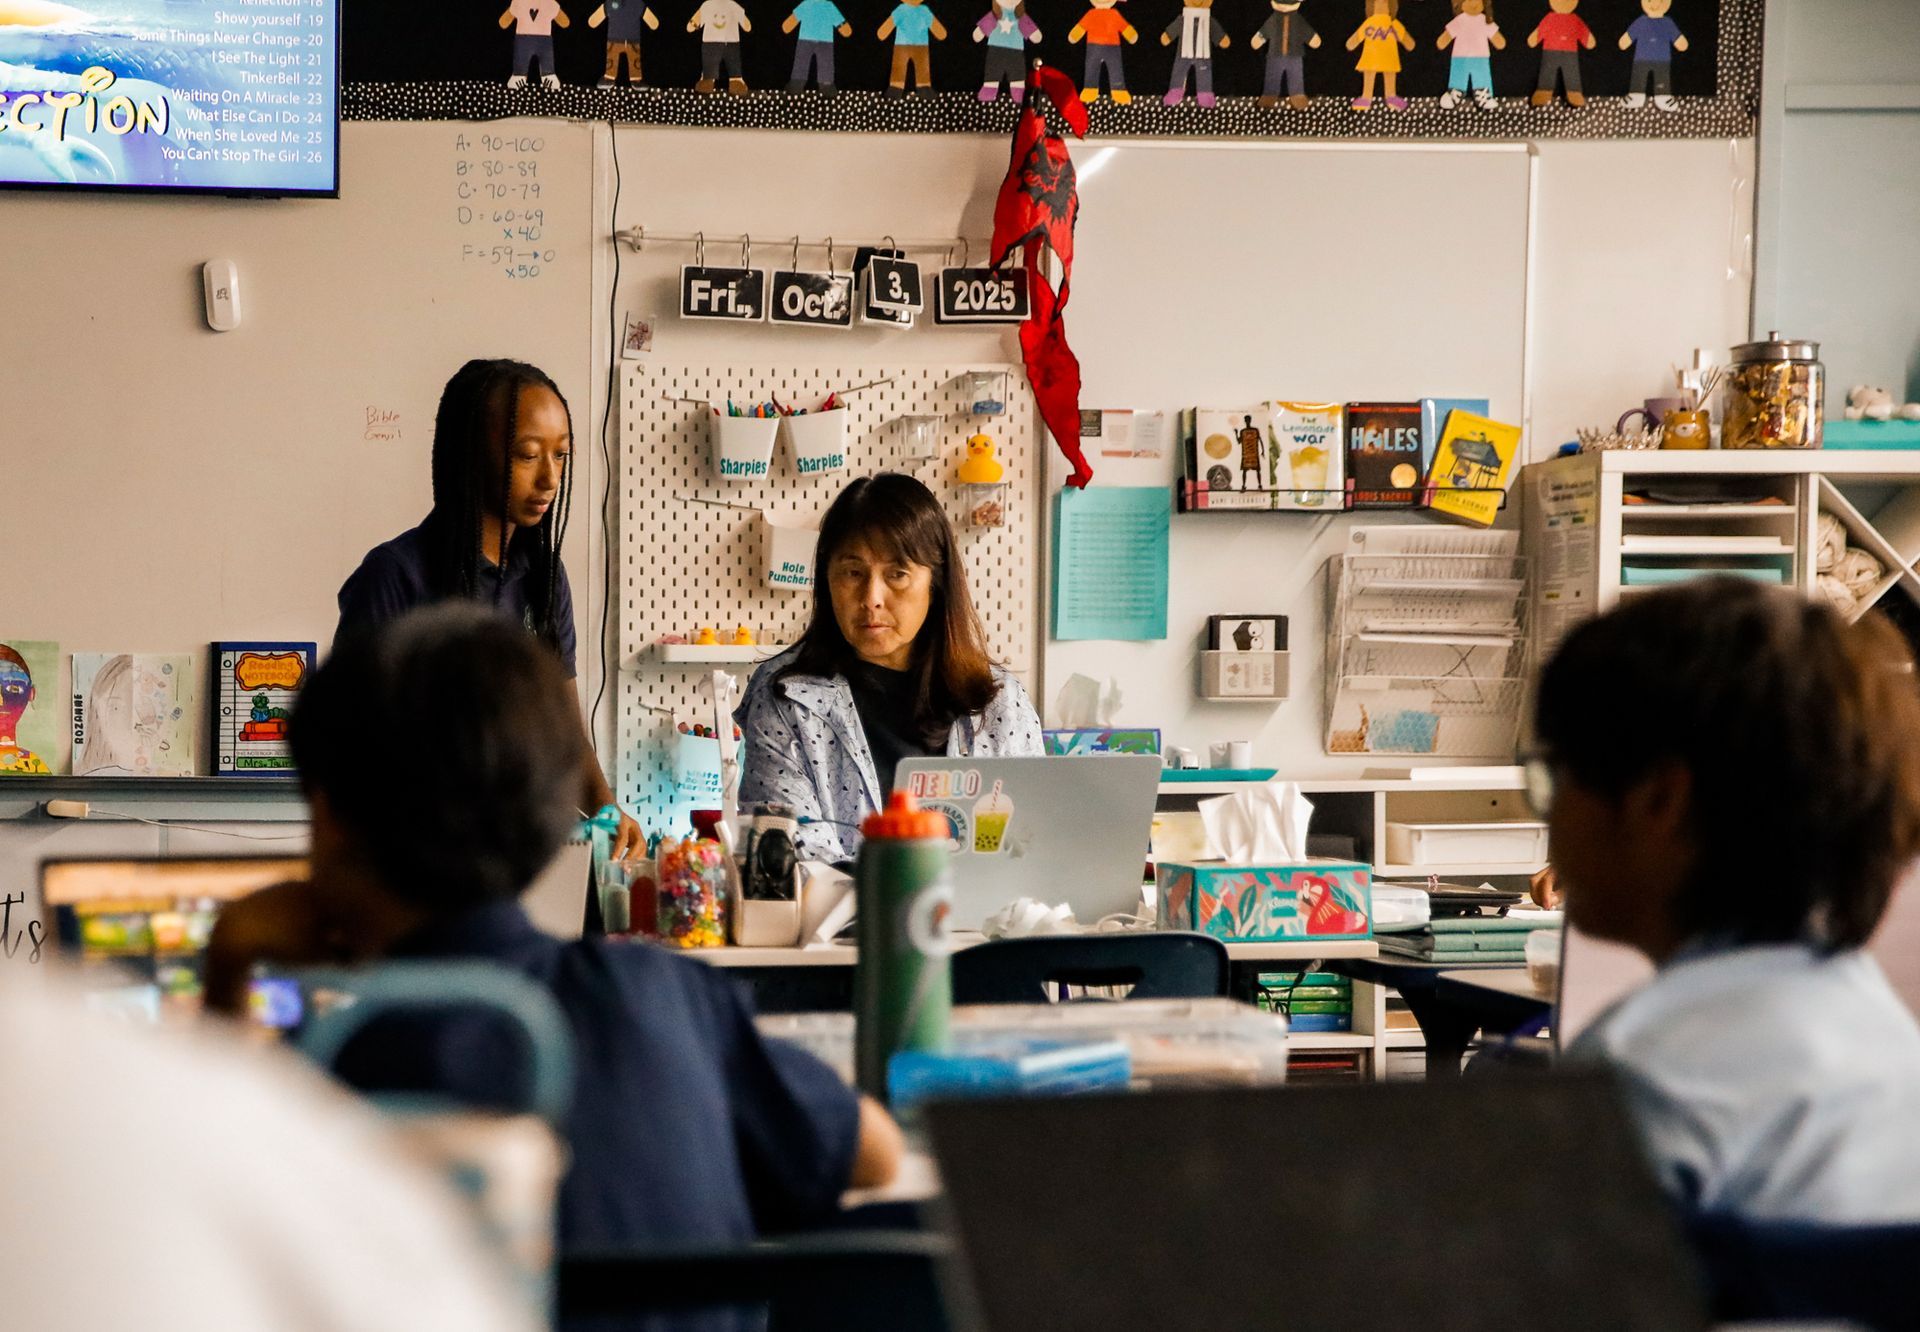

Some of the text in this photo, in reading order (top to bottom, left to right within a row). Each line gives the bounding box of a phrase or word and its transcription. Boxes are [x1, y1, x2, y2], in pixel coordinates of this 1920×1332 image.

[214, 11, 249, 25] Show
[252, 13, 301, 28] yourself
[169, 29, 210, 47] Things
[213, 30, 250, 46] Never
[252, 32, 300, 49] Change
[219, 50, 241, 65] See
[242, 51, 266, 65] The
[269, 52, 300, 68] Light
[240, 70, 300, 85] TinkerBell
[171, 88, 219, 106] Waiting
[221, 90, 240, 104] On
[243, 91, 253, 104] A
[255, 91, 300, 105] Miracle
[186, 109, 219, 122] What
[222, 110, 246, 123] Else
[248, 111, 272, 123] Can
[282, 112, 300, 124] Do
[175, 128, 212, 141] When
[214, 129, 238, 142] She
[241, 130, 277, 143] Loved
[281, 131, 300, 143] Me
[481, 135, 545, 152] 90-100
[161, 147, 185, 161] You
[187, 148, 219, 161] Can't
[221, 149, 250, 164] Stop
[253, 150, 276, 162] The
[278, 151, 300, 163] Girl
[888, 271, 910, 305] 3,
[953, 280, 1017, 312] 2025
[782, 284, 842, 321] Oct.
[1351, 426, 1419, 452] HOLES
[719, 457, 768, 477] Sharpies
[796, 453, 844, 473] Sharpies
[782, 561, 806, 574] Hole
[248, 660, 294, 672] Reading
[244, 672, 298, 681] NOTEBOOK
[74, 693, 84, 745] ROZANNE
[244, 757, 268, 768] Mrs.
[910, 771, 980, 798] HELLO
[942, 805, 967, 831] HAPPY
